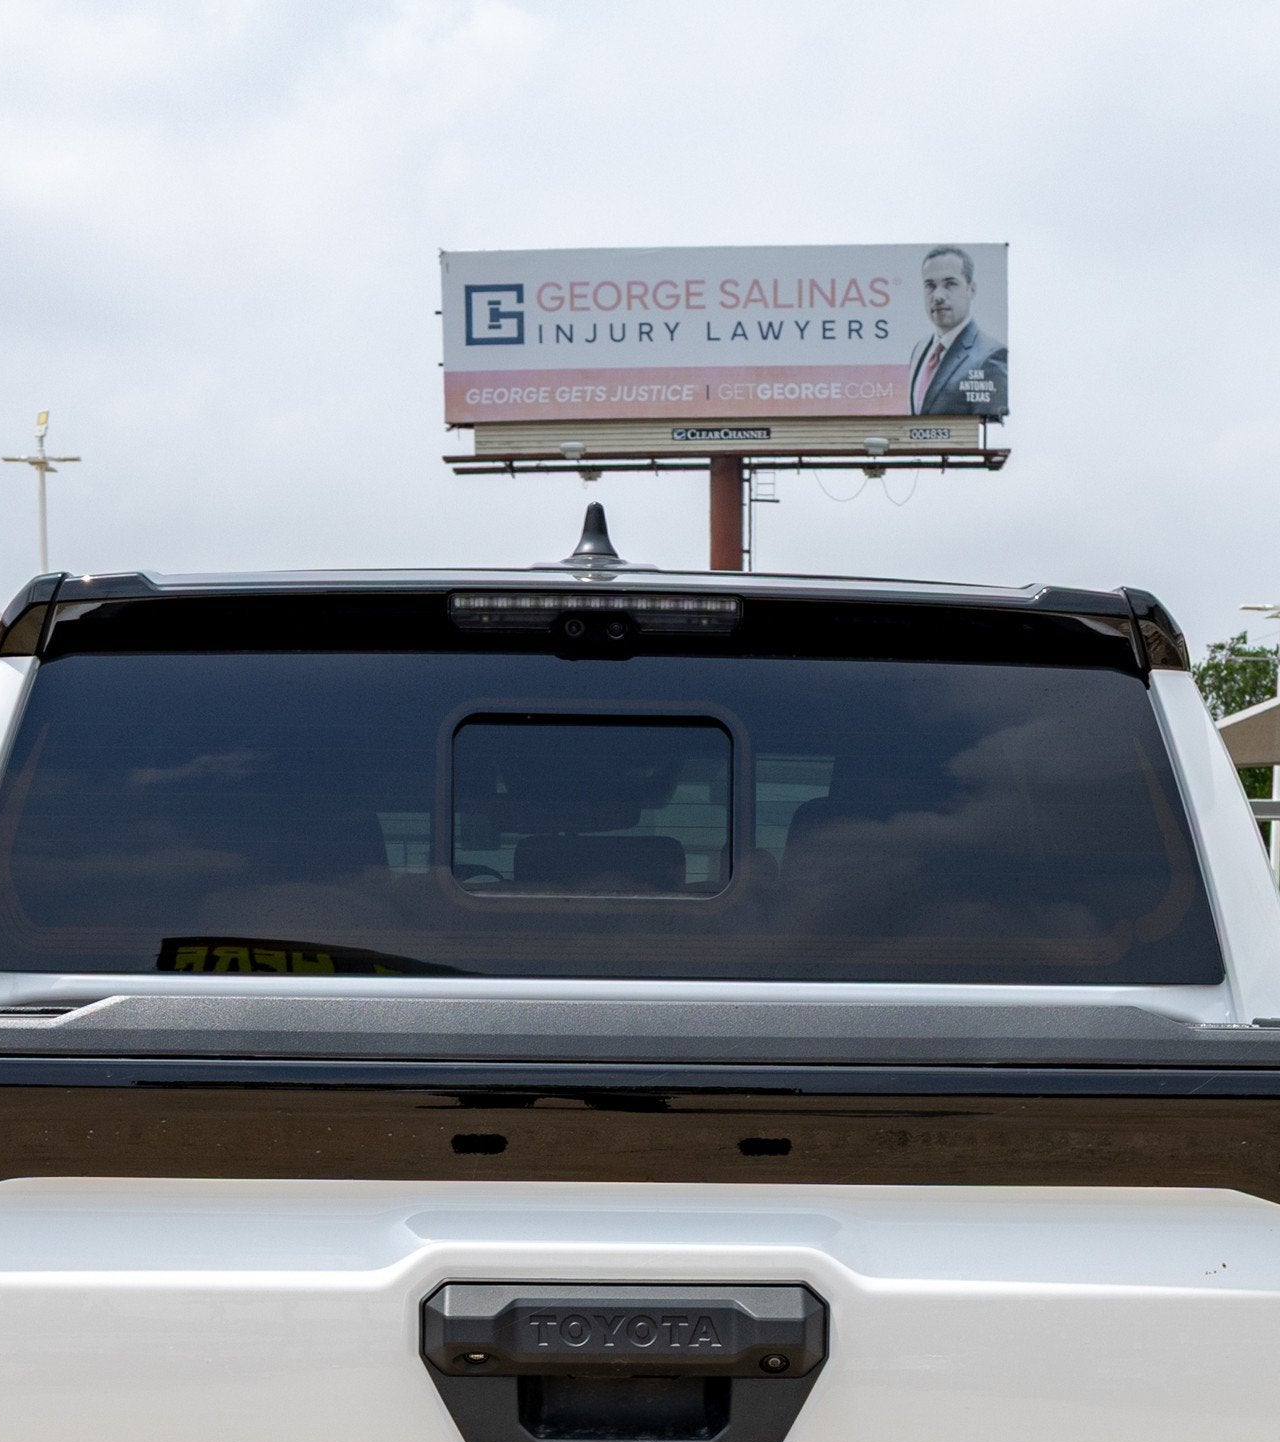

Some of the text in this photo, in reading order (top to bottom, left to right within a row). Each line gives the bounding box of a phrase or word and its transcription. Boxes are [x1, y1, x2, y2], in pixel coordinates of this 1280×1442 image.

[536, 276, 890, 312] GEORGE SALINAS
[538, 319, 889, 344] INJURY LAWYERS
[968, 369, 984, 380] SAN
[465, 386, 550, 405] GEORGE
[555, 385, 607, 403] GETS
[610, 384, 694, 402] JUSTICE
[959, 380, 997, 393] ANTONIO,
[965, 391, 991, 403] TEXAS
[911, 429, 949, 440] 004833
[530, 1315, 722, 1347] TOYOTA
